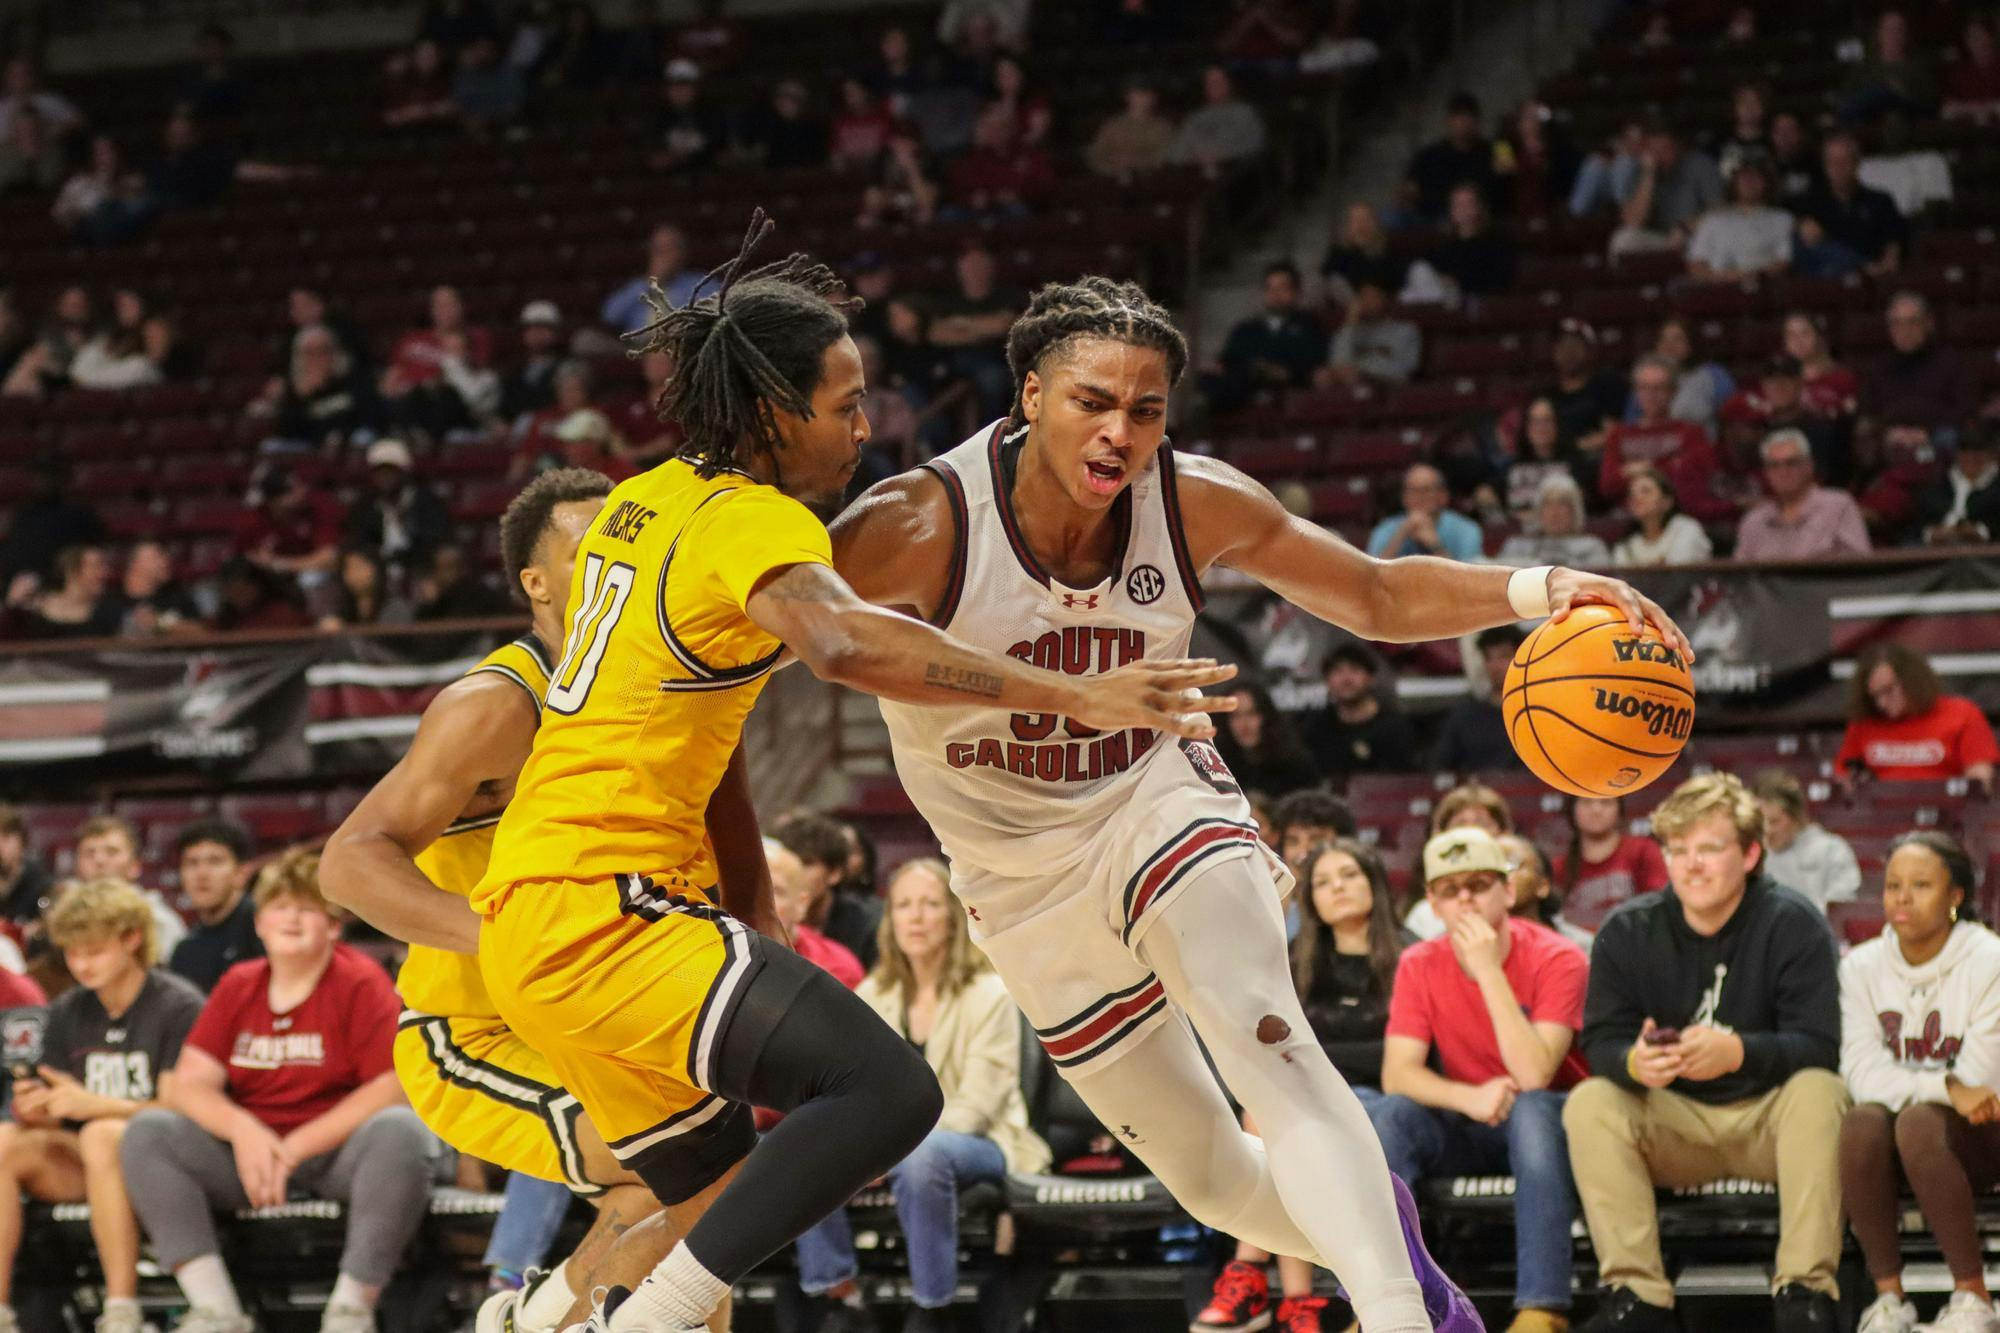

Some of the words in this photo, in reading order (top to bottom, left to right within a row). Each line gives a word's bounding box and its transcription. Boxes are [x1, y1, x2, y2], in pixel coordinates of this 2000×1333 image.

[1130, 567, 1162, 602] SEC
[545, 552, 637, 716] 10
[1613, 639, 1685, 673] NCAA
[1595, 689, 1691, 740] Wilson
[1036, 1184, 1145, 1203] GAMECOCKS
[1453, 1177, 1517, 1197] GAMEC
